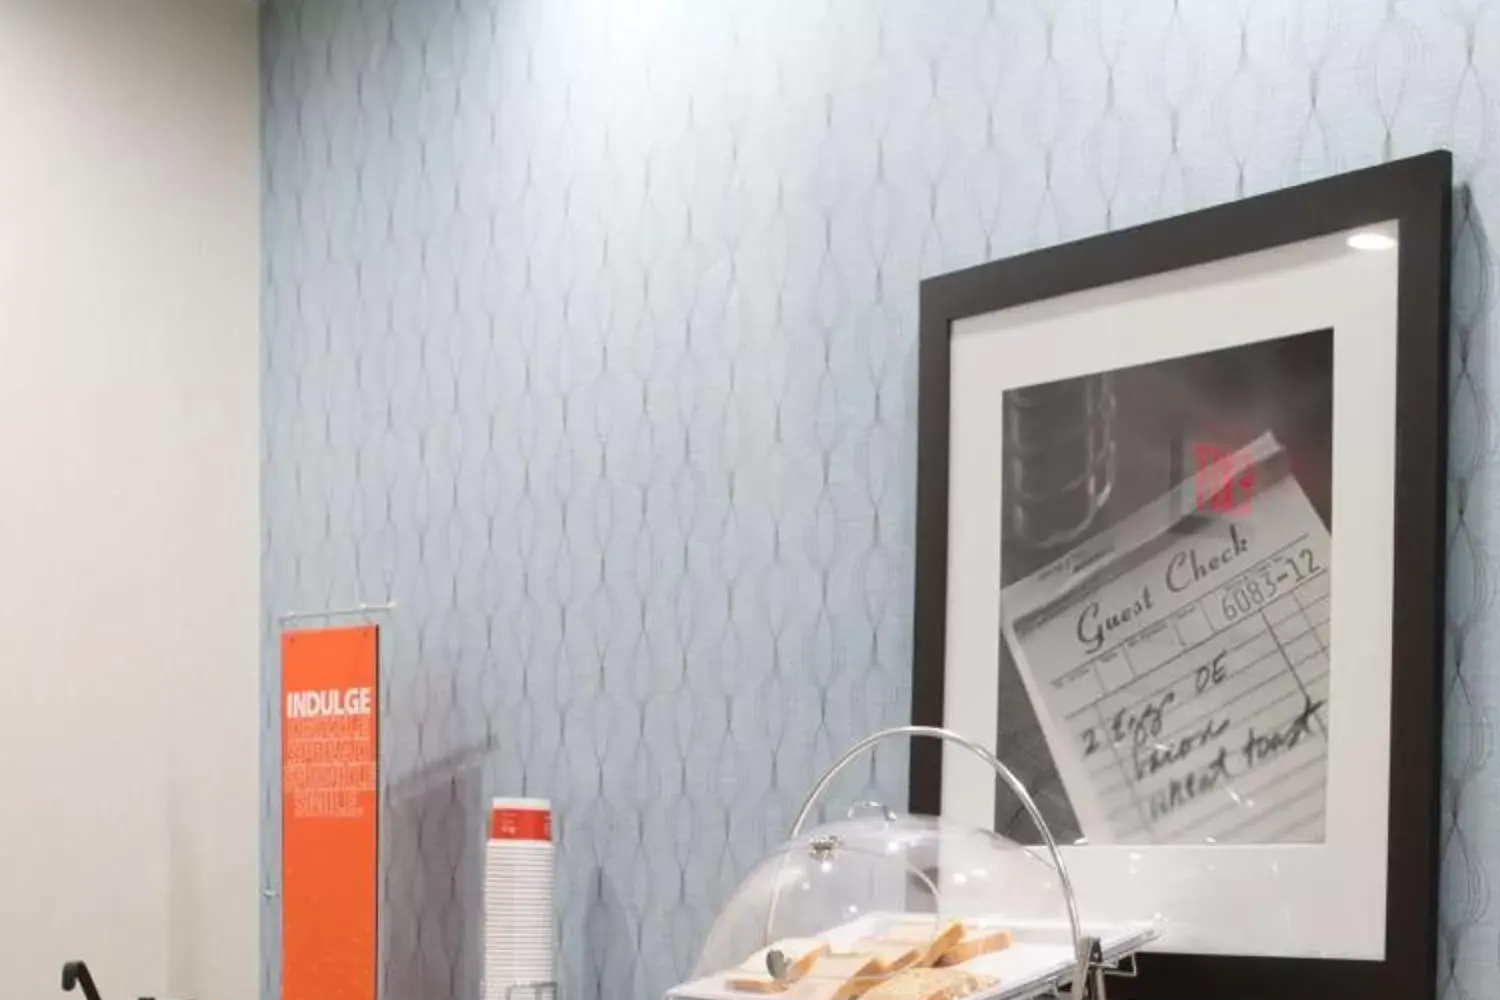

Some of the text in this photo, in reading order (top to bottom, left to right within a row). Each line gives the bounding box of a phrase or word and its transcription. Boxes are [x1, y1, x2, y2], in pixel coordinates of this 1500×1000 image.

[1076, 585, 1154, 654] Guest
[1164, 524, 1248, 594] Check
[287, 687, 371, 718] INDULGE
